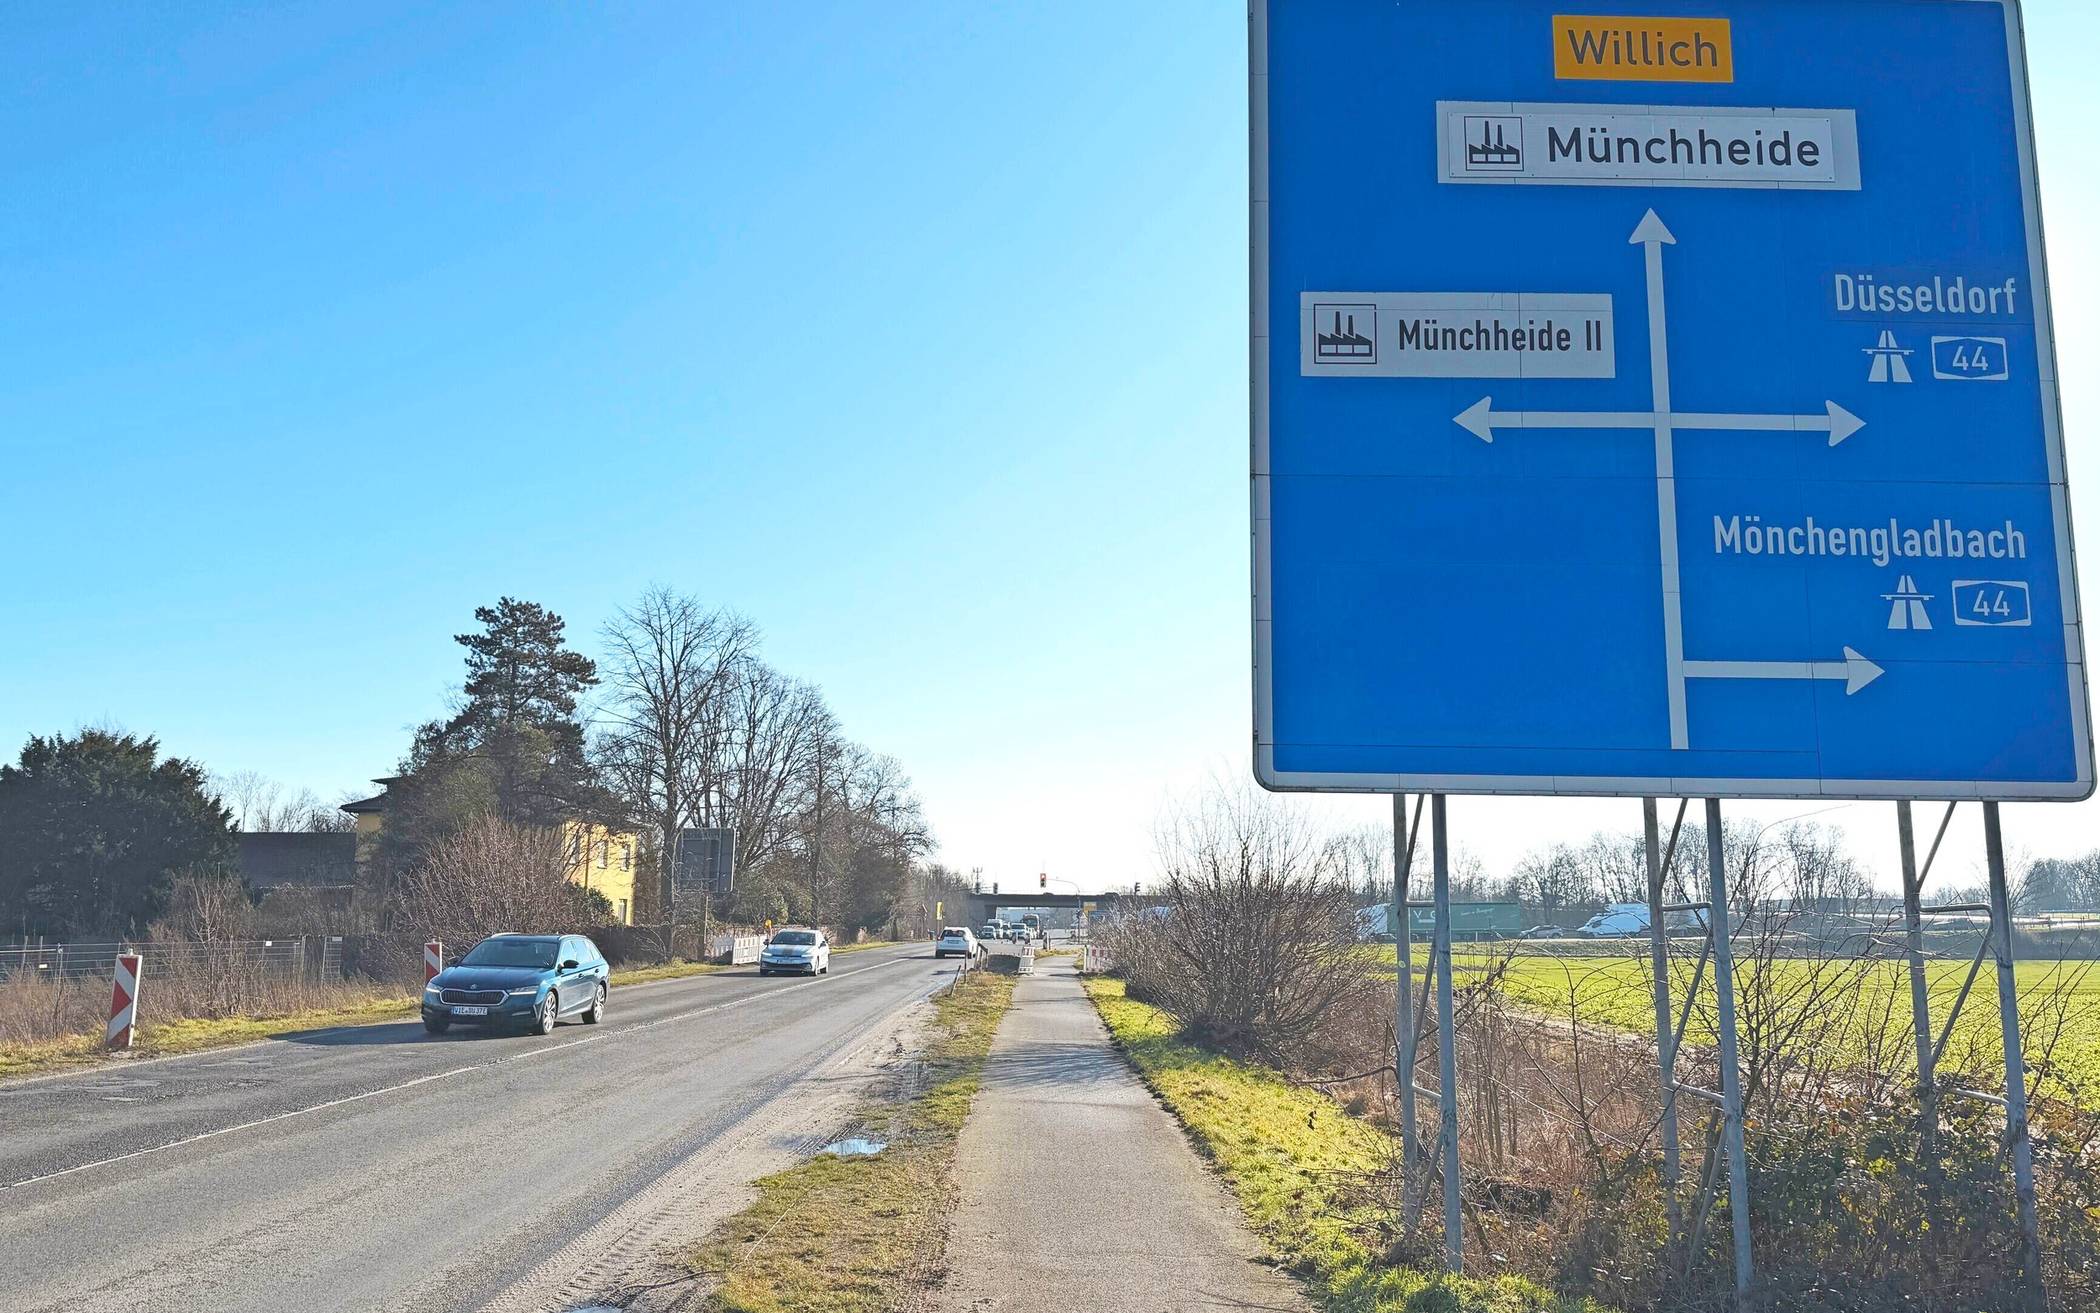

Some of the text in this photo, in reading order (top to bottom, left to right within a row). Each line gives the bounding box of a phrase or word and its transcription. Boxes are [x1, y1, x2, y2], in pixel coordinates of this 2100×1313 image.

[1568, 30, 1718, 67] Willich
[1548, 127, 1820, 167] Münchheide
[1835, 274, 2016, 315] Düsseldorf
[1399, 319, 1602, 352] Münchheide II
[1953, 346, 1989, 371] 44
[1714, 516, 2026, 568] Mönchengladbach
[1974, 590, 2011, 617] 44
